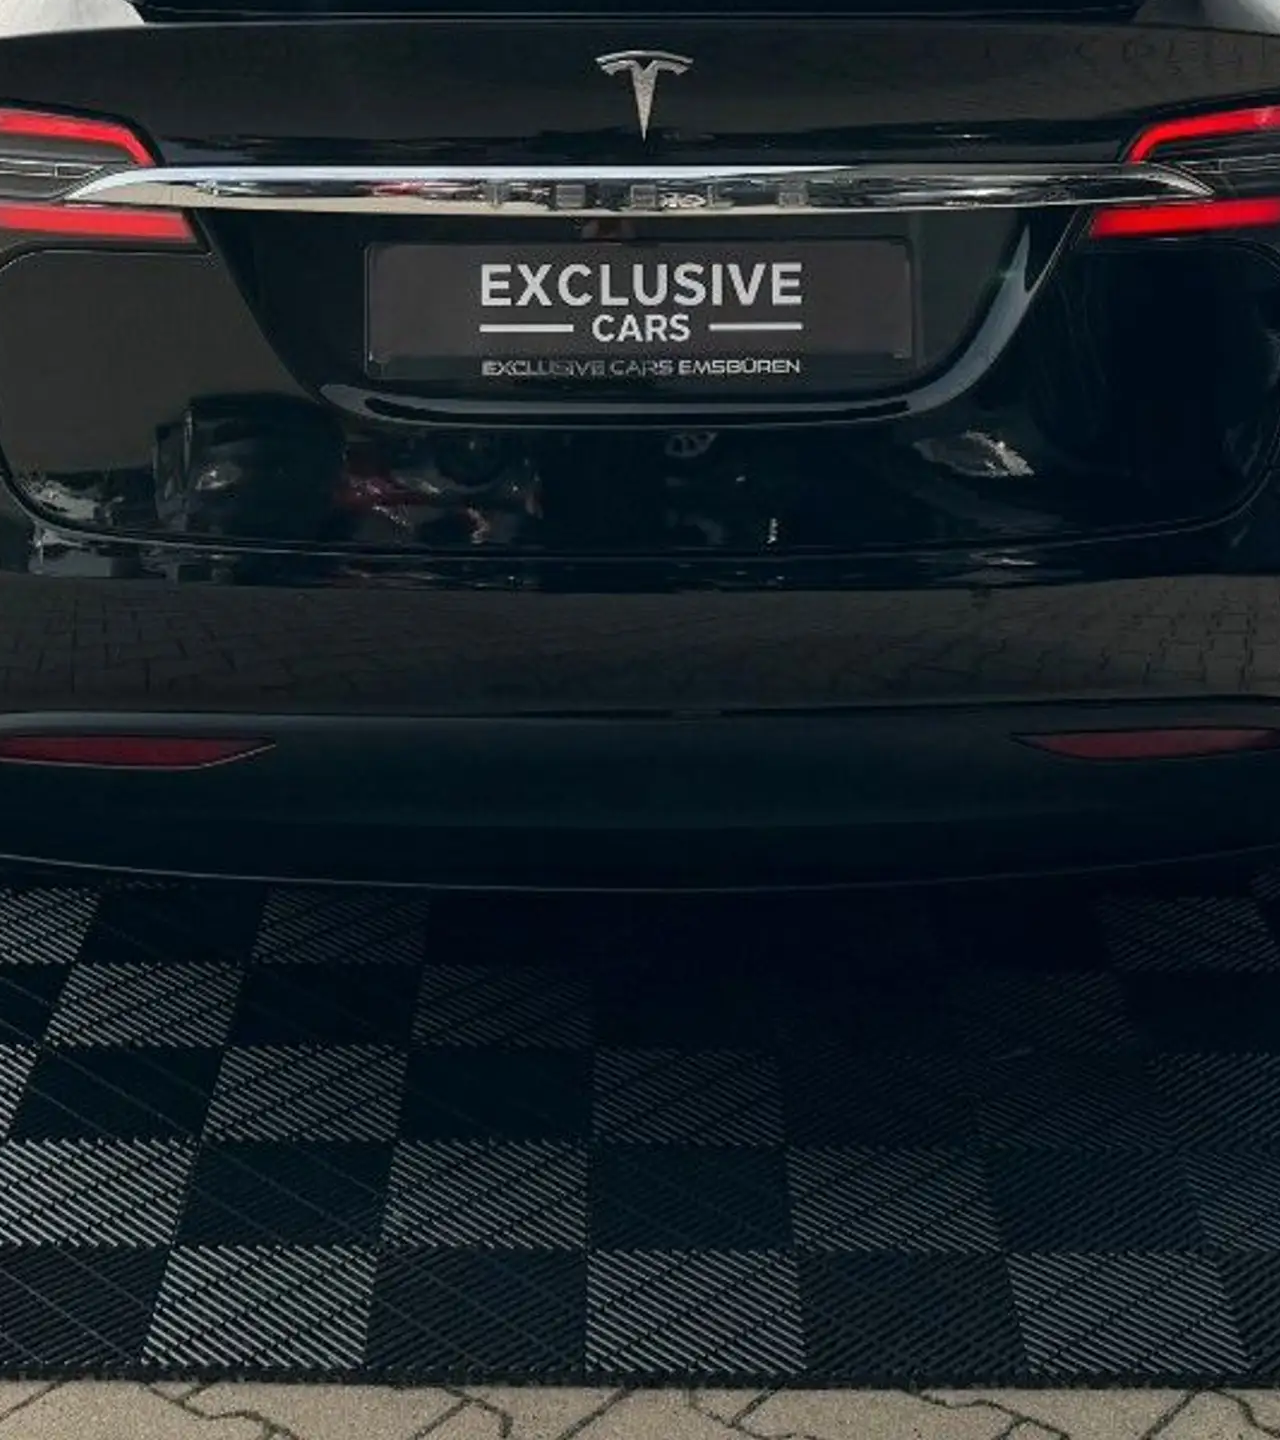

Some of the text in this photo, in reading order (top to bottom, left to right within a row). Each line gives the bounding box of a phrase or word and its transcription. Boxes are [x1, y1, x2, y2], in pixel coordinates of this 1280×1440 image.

[479, 261, 803, 307] EXCLUSIVE
[592, 313, 691, 343] CARS
[481, 355, 801, 377] EXCLUSIVE CARS EMSBÜREN
